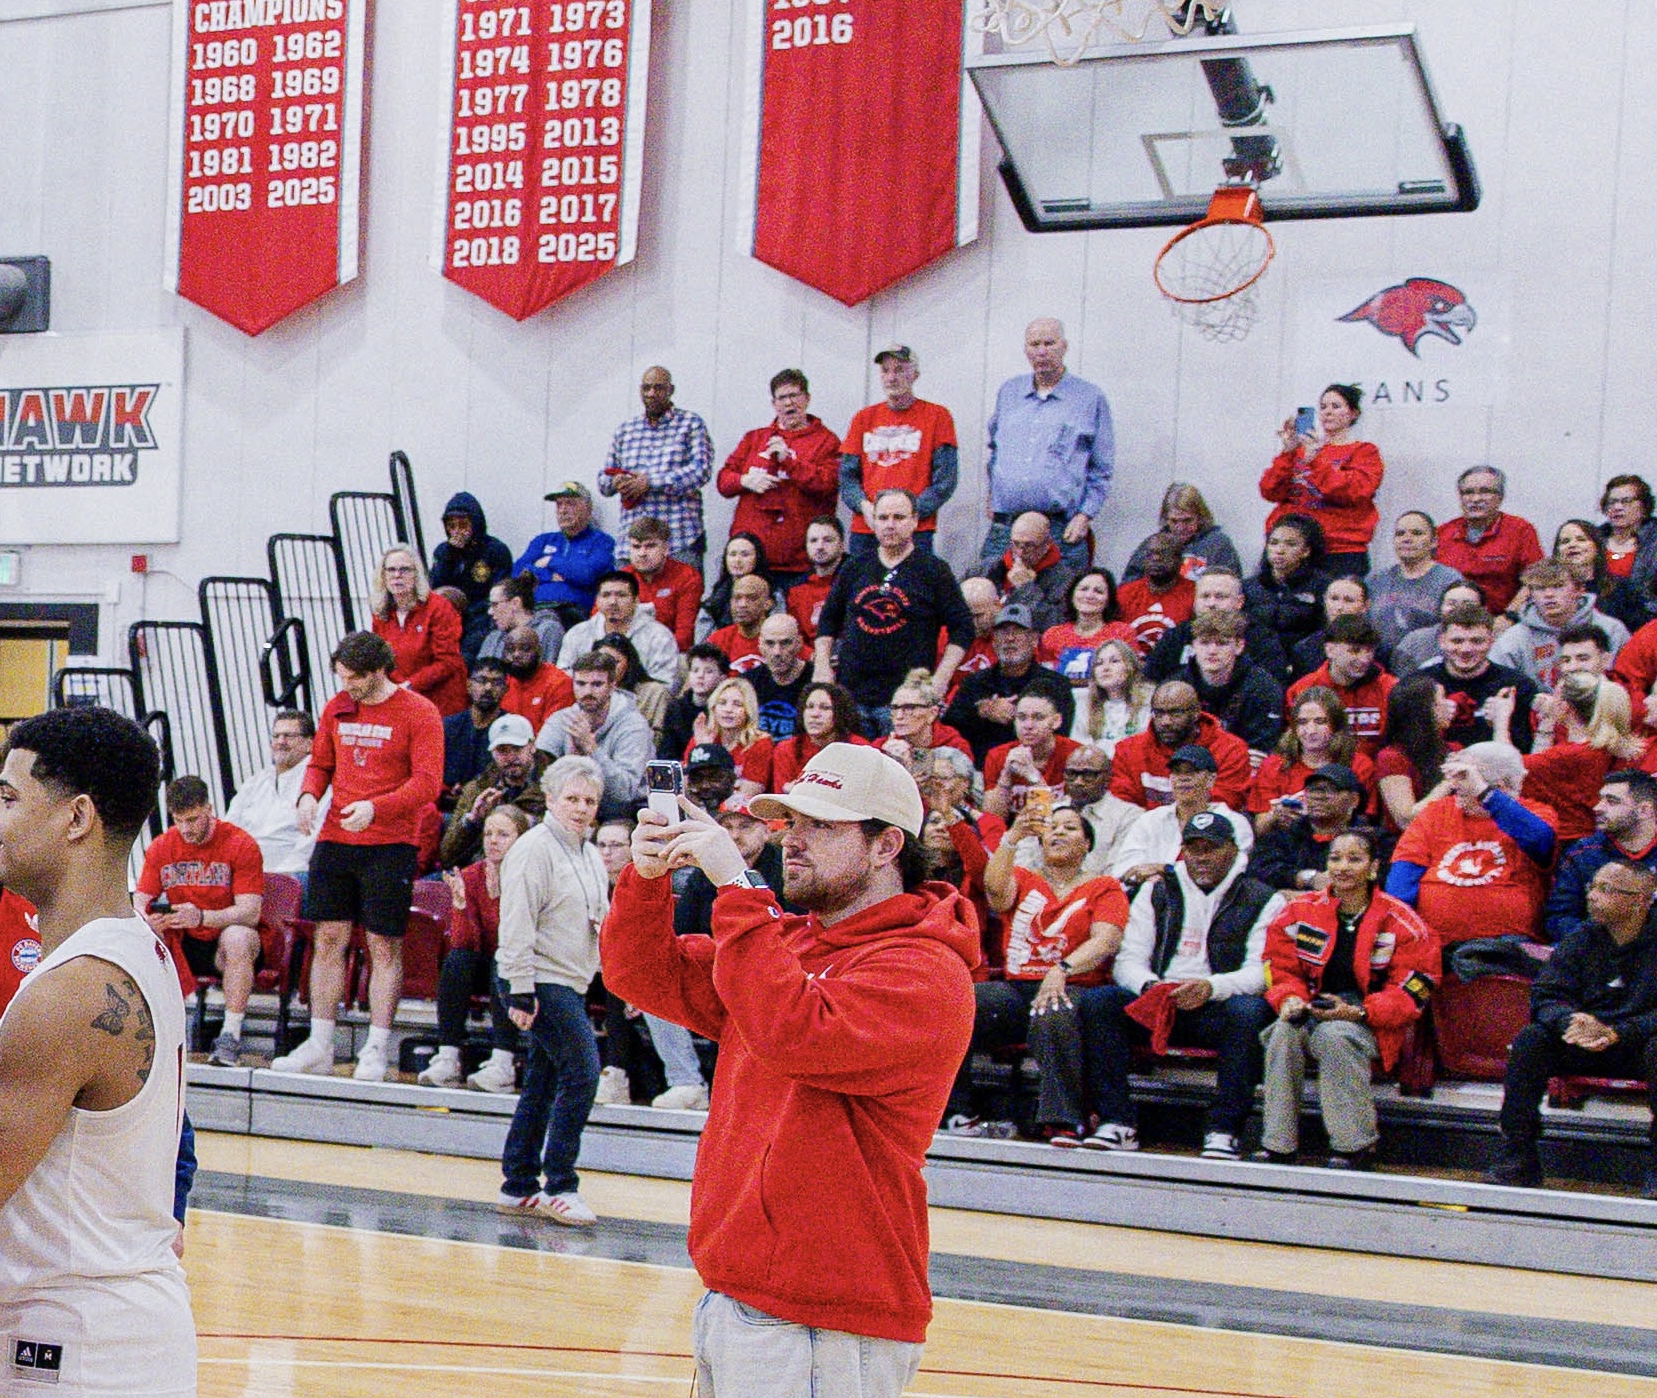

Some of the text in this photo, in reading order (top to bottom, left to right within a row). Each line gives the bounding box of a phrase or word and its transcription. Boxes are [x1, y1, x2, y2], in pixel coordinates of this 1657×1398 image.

[194, 0, 343, 33] CHAMPIONS
[461, 0, 625, 41] 1971 1973
[772, 12, 854, 50] 2016
[192, 29, 342, 71] 1960 1962
[459, 38, 623, 79] 1974 1976
[191, 66, 340, 106] 1968 1969
[458, 78, 621, 117] 1977 1978
[190, 103, 338, 142] 1970 1971
[456, 116, 620, 155] 1995 2013
[188, 139, 337, 178] 1981 1982
[455, 155, 618, 192] 2014 2015
[188, 176, 335, 213] 2003 2025
[454, 193, 617, 230] 2016 2017
[452, 232, 616, 268] 2018 2025
[1370, 378, 1451, 404] ANS
